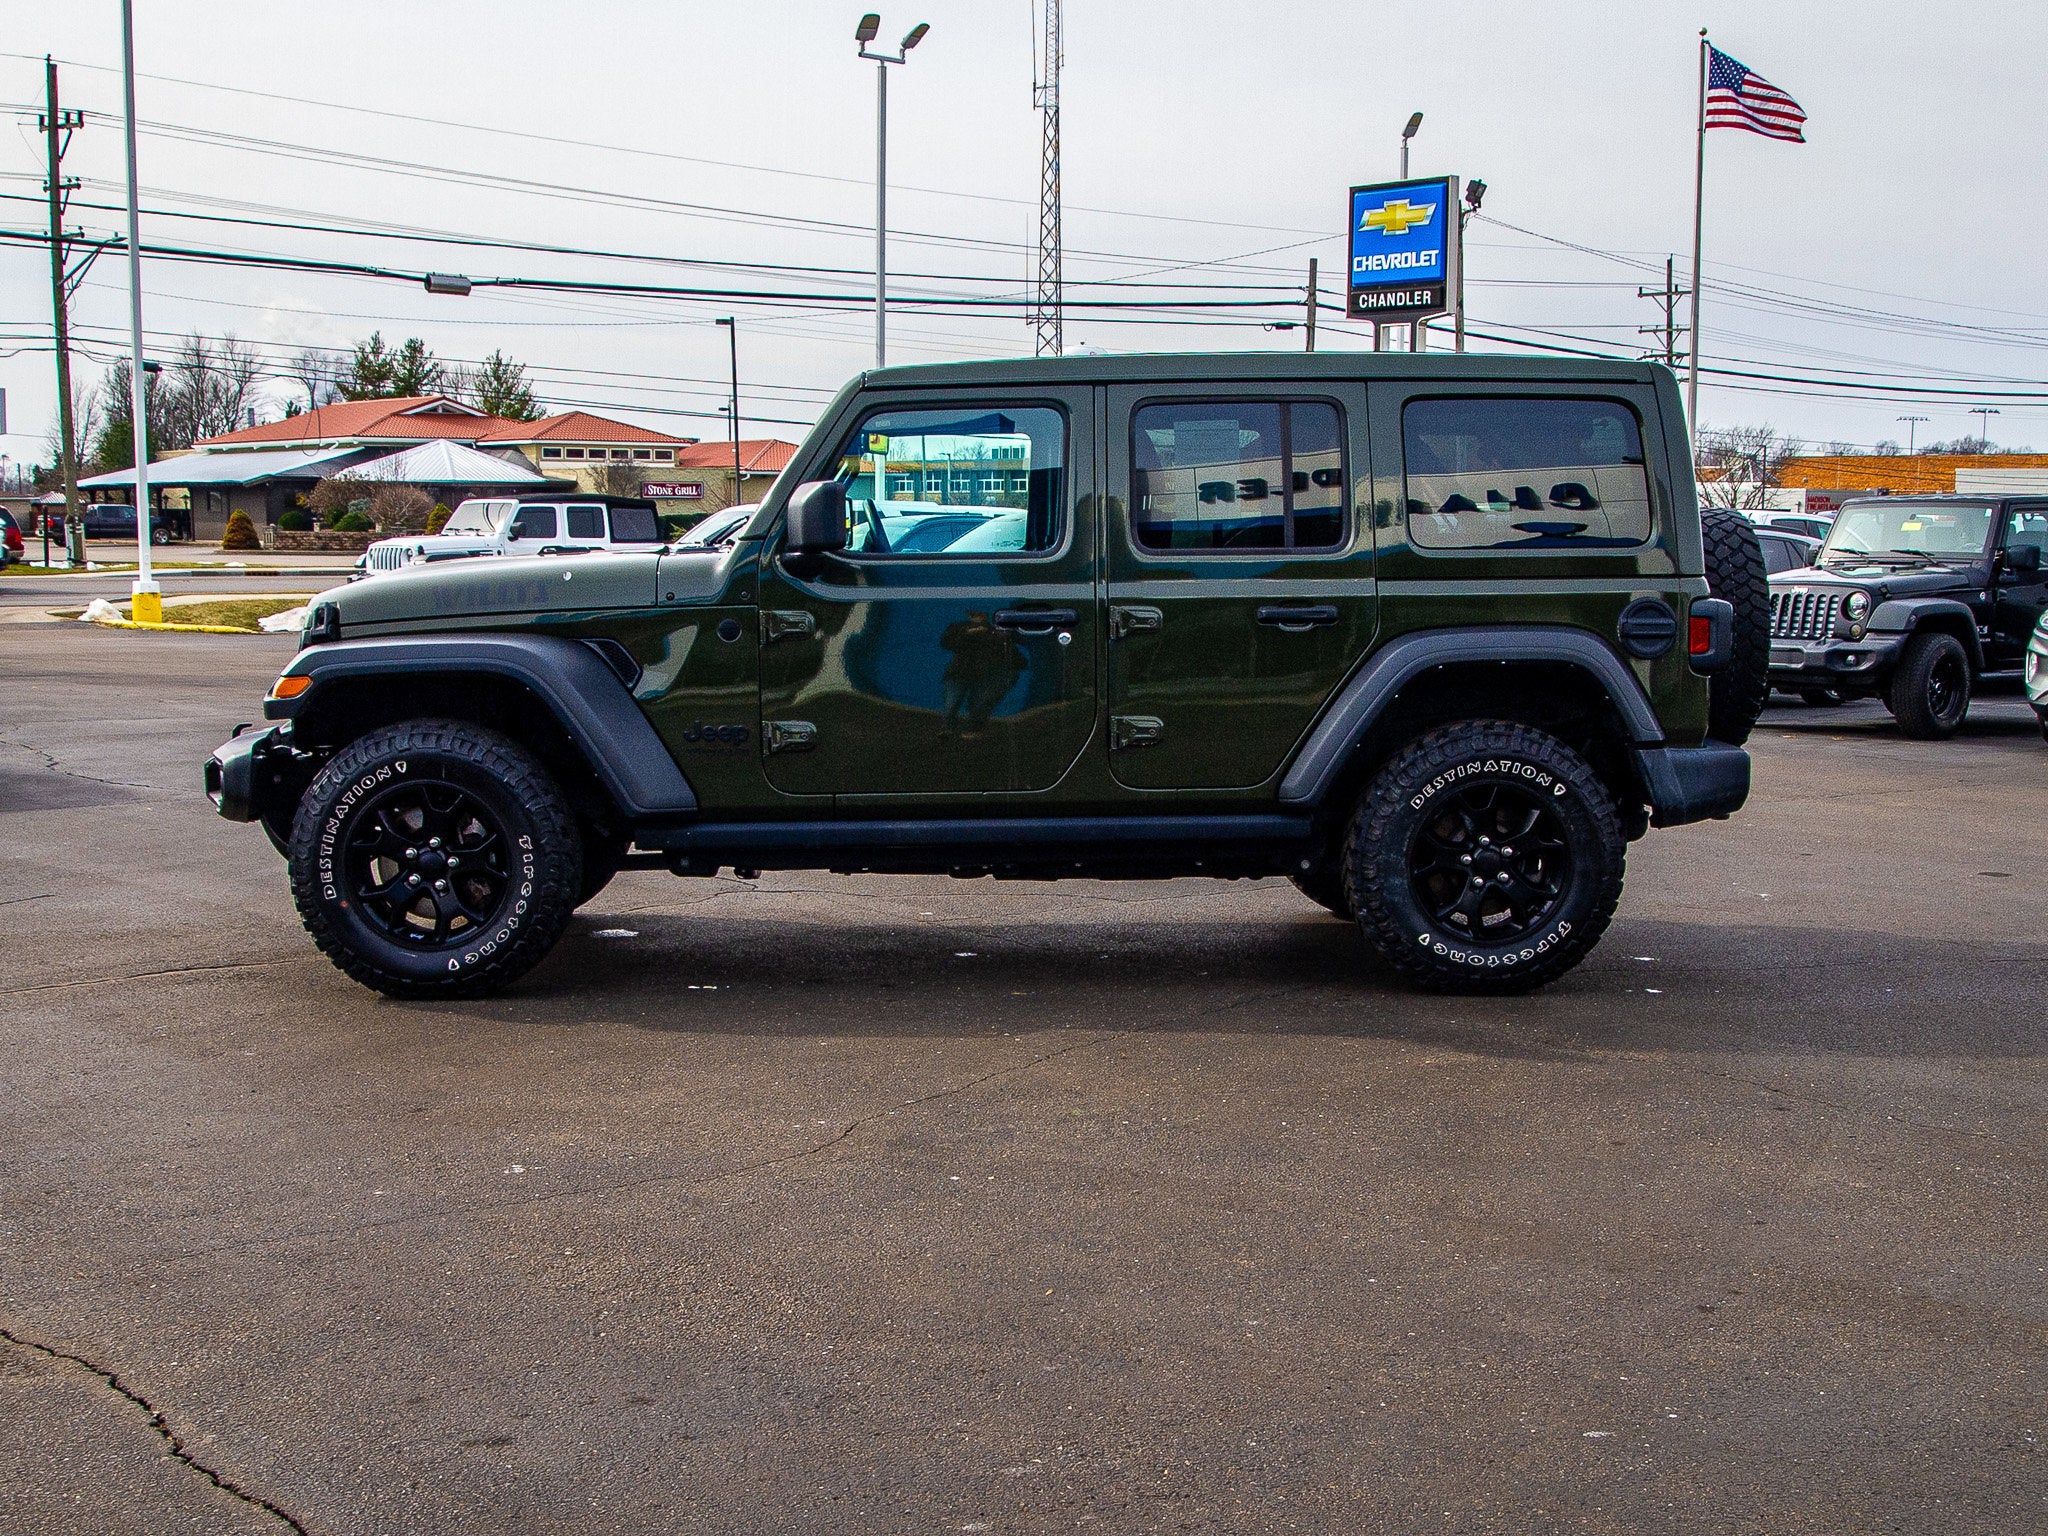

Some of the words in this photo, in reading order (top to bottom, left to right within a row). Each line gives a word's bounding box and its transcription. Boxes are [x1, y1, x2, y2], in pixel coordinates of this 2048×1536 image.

[1353, 249, 1440, 273] CHEVROLET
[1358, 290, 1432, 309] CHANDLER
[647, 484, 673, 496] STONE
[674, 485, 698, 496] GRILL
[683, 720, 750, 744] Jeep
[1410, 760, 1552, 810] DESTINATION
[319, 765, 392, 900] DESTINATION
[464, 834, 534, 964] Firestone
[1433, 920, 1572, 968] Firestone
